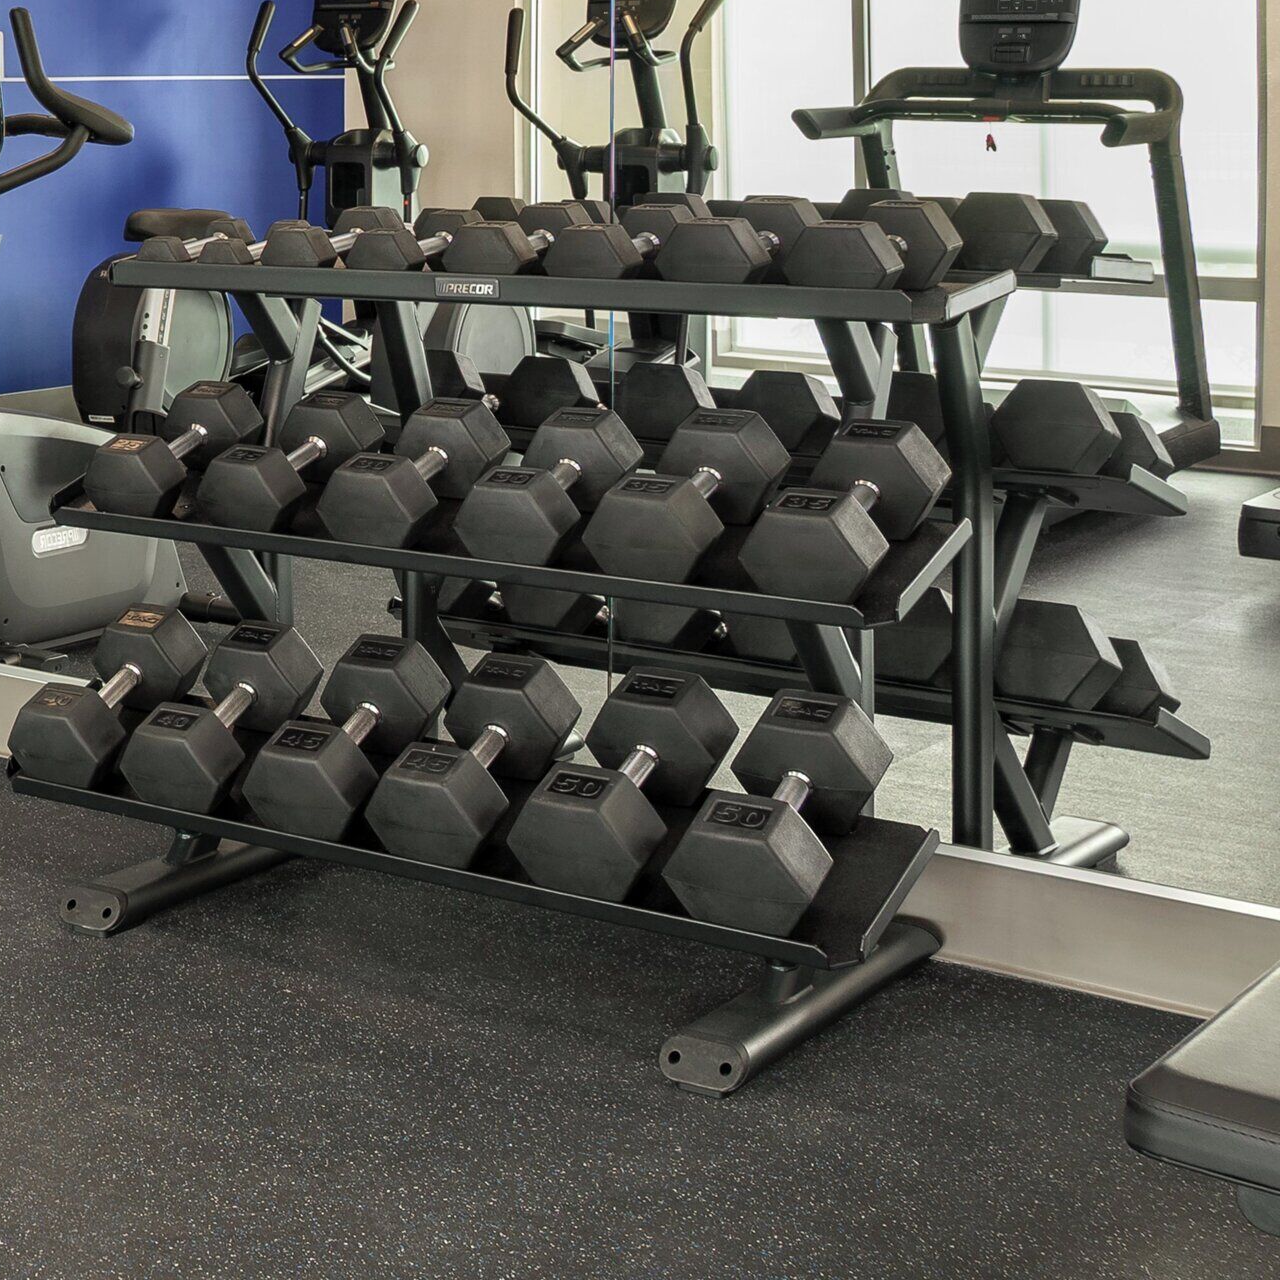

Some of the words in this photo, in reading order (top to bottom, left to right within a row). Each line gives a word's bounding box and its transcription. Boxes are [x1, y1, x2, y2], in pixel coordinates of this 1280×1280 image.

[445, 282, 494, 295] PRECOR
[786, 496, 832, 511] 35
[281, 733, 325, 749] 45
[552, 778, 603, 798] 50
[712, 806, 766, 828] 50
